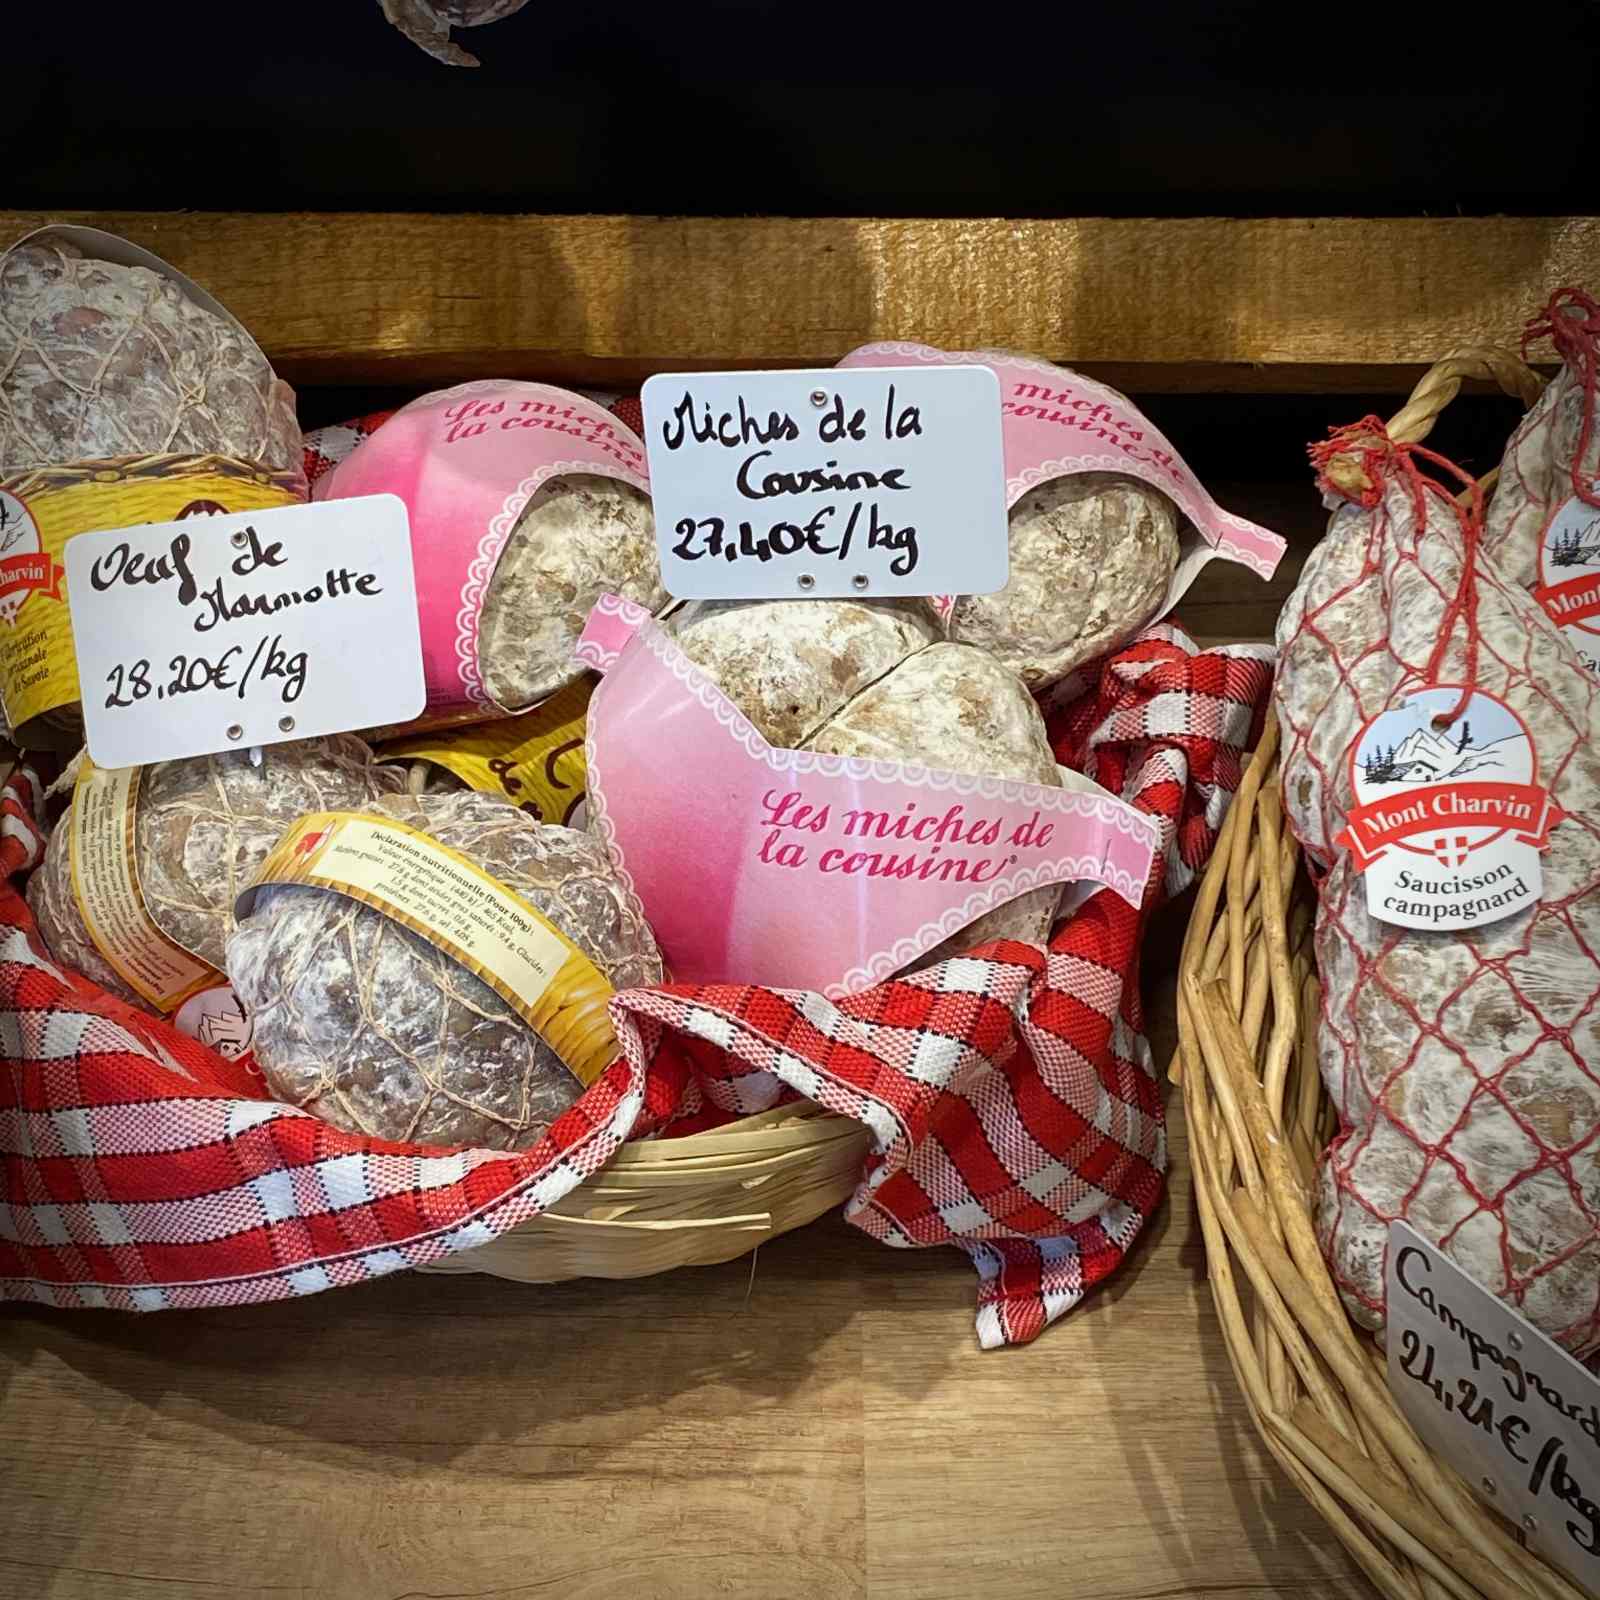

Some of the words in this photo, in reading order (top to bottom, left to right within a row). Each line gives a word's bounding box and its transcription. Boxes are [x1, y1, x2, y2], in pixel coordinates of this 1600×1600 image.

[444, 399, 505, 426] Les
[519, 400, 642, 462] miches
[446, 420, 488, 443] la
[663, 390, 799, 450] Miches
[819, 394, 866, 443] de
[886, 383, 922, 440] la
[1014, 383, 1145, 441] miches
[736, 450, 911, 500] Cousine
[232, 526, 288, 576] de
[193, 568, 384, 632] Marmotte
[760, 789, 831, 832] Les
[842, 802, 1002, 846] miches
[1004, 811, 1055, 848] de
[1361, 802, 1427, 838] Mont
[1432, 791, 1532, 820] Charvin
[757, 829, 808, 868] la
[421, 854, 486, 897] nutritionnelle
[1383, 877, 1530, 923] campagnard
[1394, 862, 1514, 895] Saucisson
